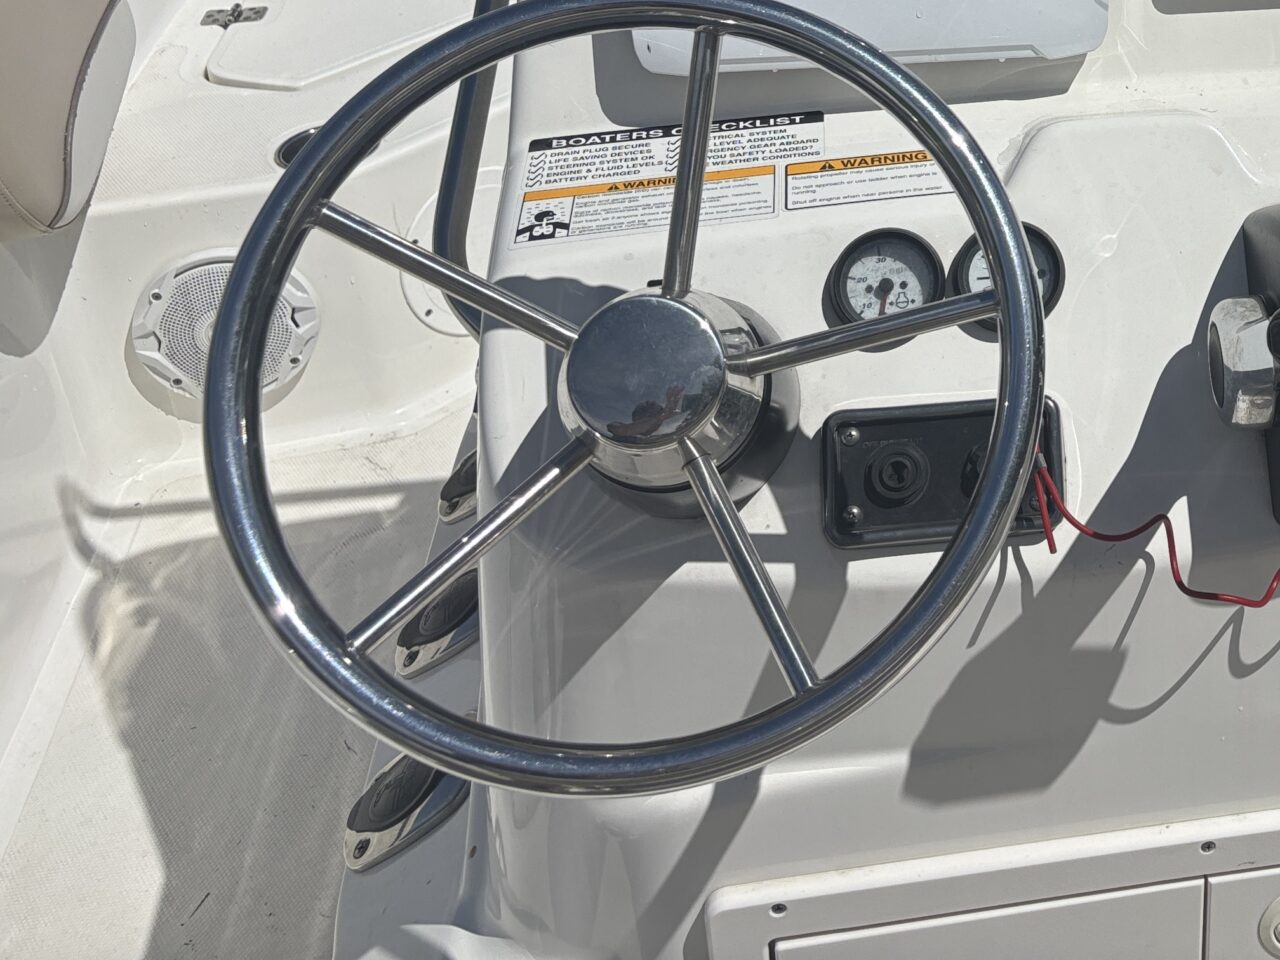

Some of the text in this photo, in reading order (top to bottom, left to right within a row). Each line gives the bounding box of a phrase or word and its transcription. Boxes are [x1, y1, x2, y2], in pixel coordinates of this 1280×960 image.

[551, 115, 806, 149] BOATERS CECKLIST
[749, 128, 788, 137] SYSTEM
[714, 134, 798, 147] LEVEL ADEQUATE
[749, 142, 776, 150] GEAR
[779, 138, 819, 147] ABOARD
[548, 148, 652, 165] LIFE SAVING DEVICES
[550, 142, 652, 159] DRAIN PLUG SECURE
[729, 149, 767, 158] SAFETY
[769, 145, 814, 154] LOADED?
[547, 161, 597, 171] STEERING
[599, 158, 636, 166] SYSTEM
[712, 151, 821, 166] WEATHER CONDITIONS
[841, 152, 928, 168] WARNING
[546, 169, 583, 178] ENGINE
[596, 164, 624, 172] FLUID
[626, 160, 664, 169] LEVELS
[545, 170, 641, 185] BATTERY CHARGED
[623, 178, 676, 189] WARNI
[875, 256, 887, 264] 30
